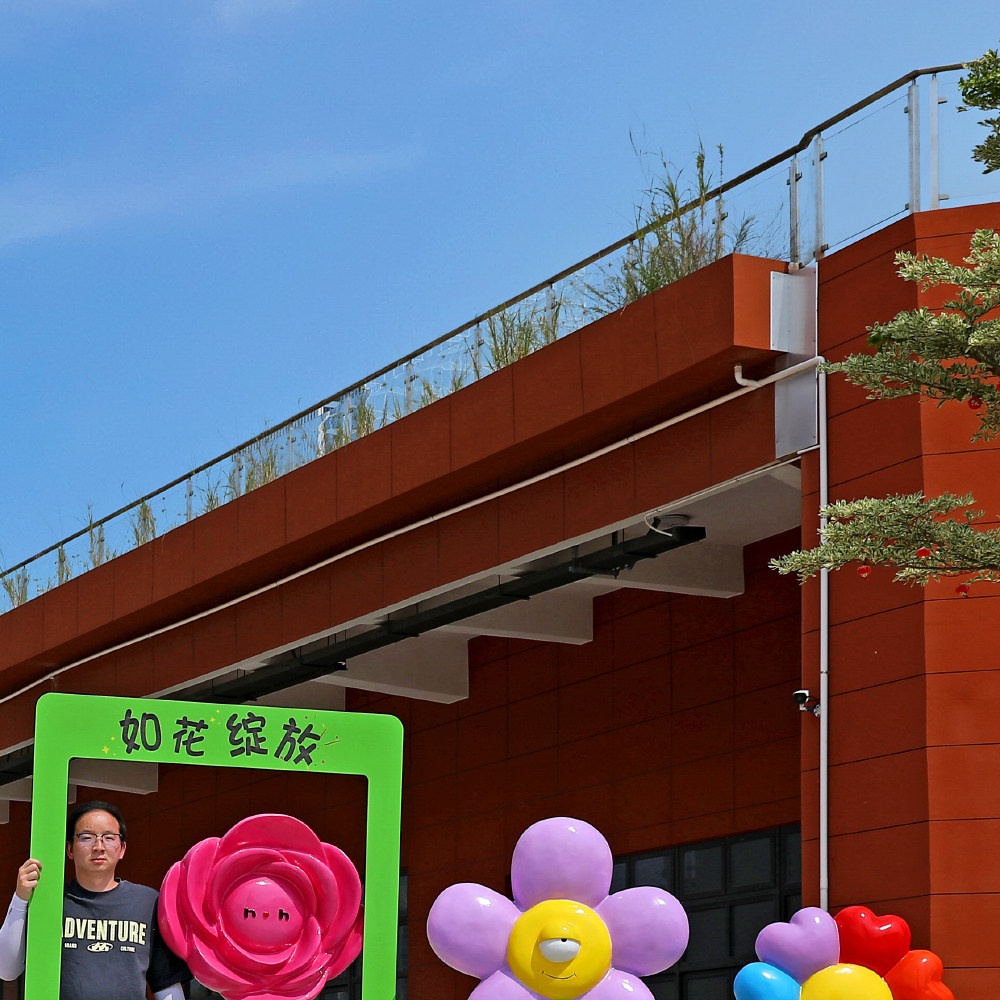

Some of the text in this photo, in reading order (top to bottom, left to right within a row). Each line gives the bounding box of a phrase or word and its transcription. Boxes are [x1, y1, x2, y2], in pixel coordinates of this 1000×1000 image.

[119, 709, 321, 765] 如花绽放
[62, 917, 147, 945] DVENTURE
